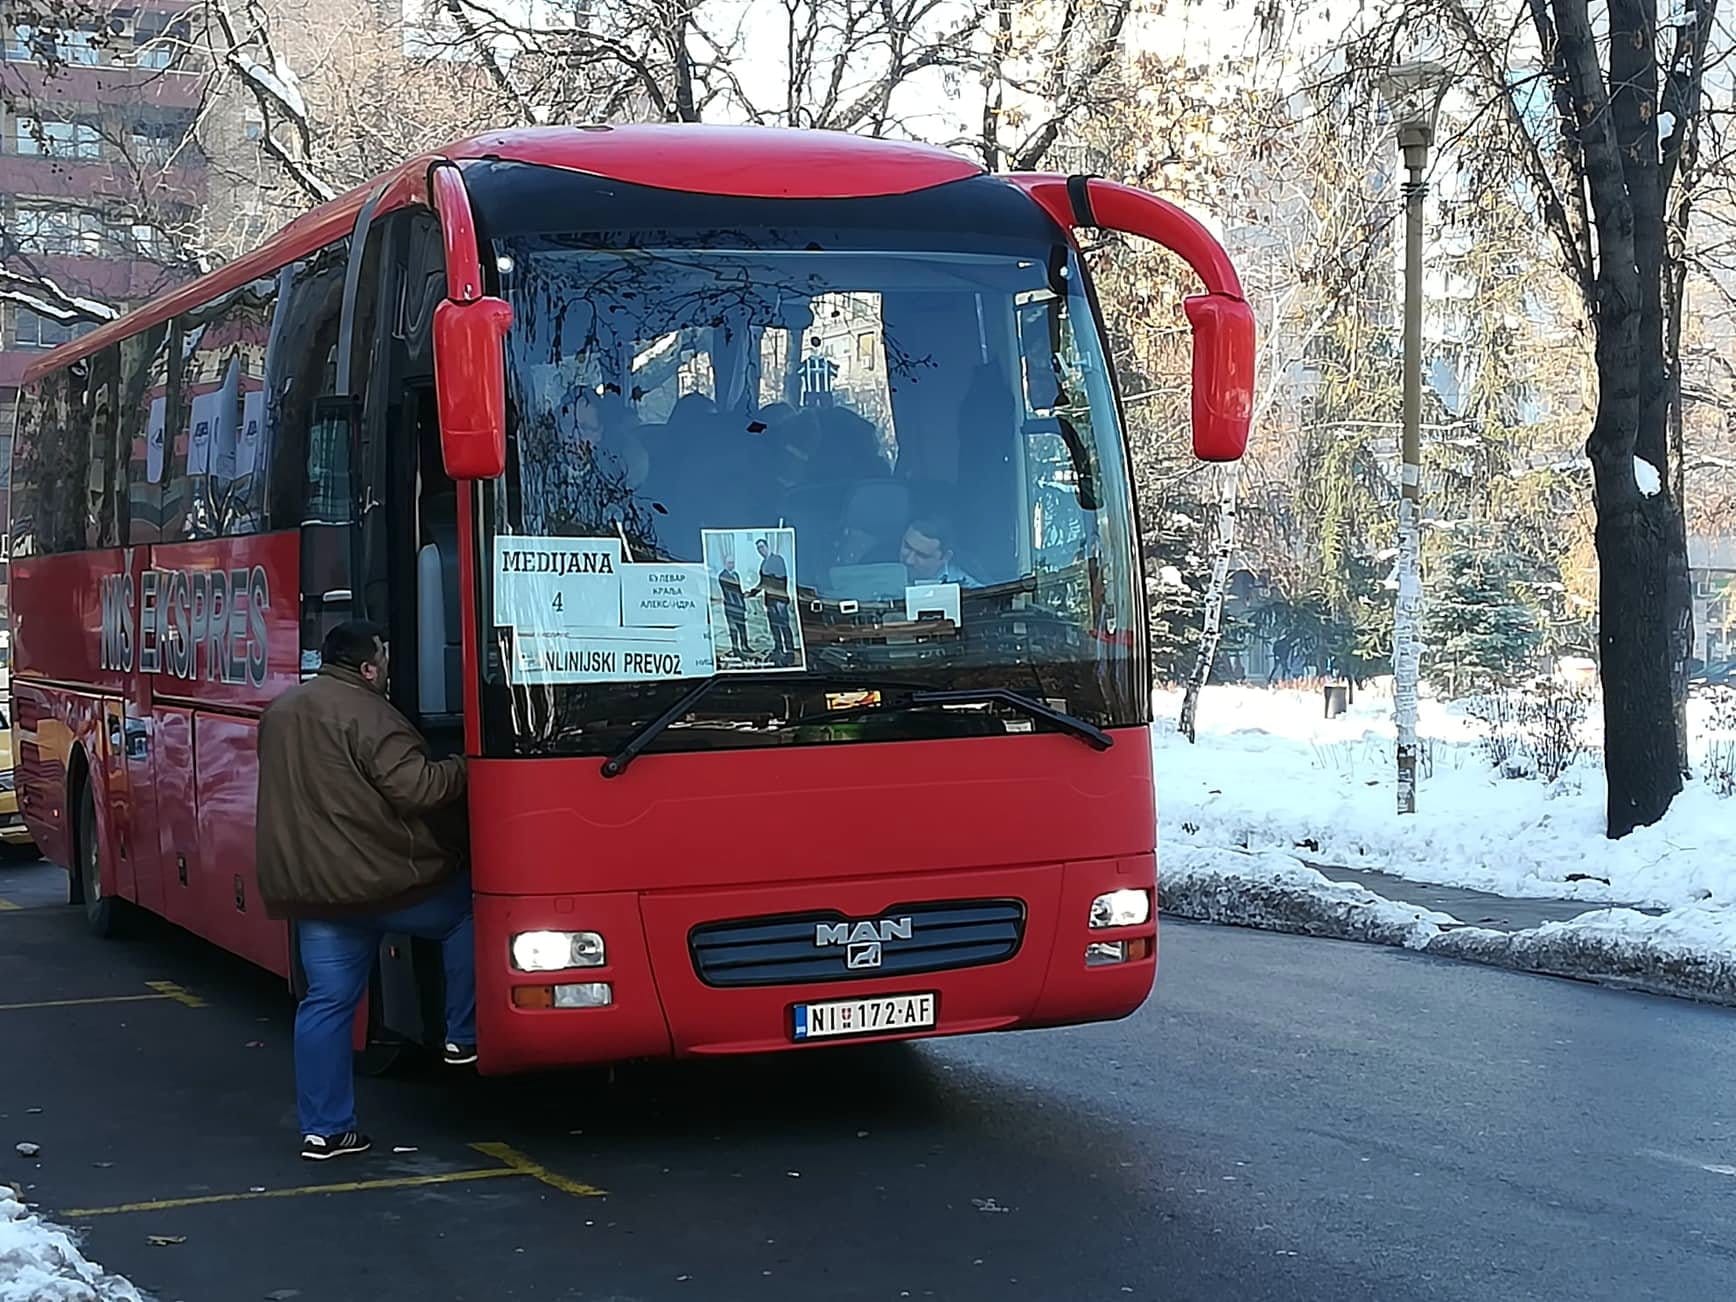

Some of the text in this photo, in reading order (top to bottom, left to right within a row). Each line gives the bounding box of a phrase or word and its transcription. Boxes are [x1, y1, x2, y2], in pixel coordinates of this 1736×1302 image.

[502, 551, 614, 576] MEDIJANA
[551, 591, 563, 612] 4
[101, 548, 270, 688] NIŠ EKSPRES
[545, 651, 616, 673] NLINIJSKI
[816, 917, 912, 946] MAN
